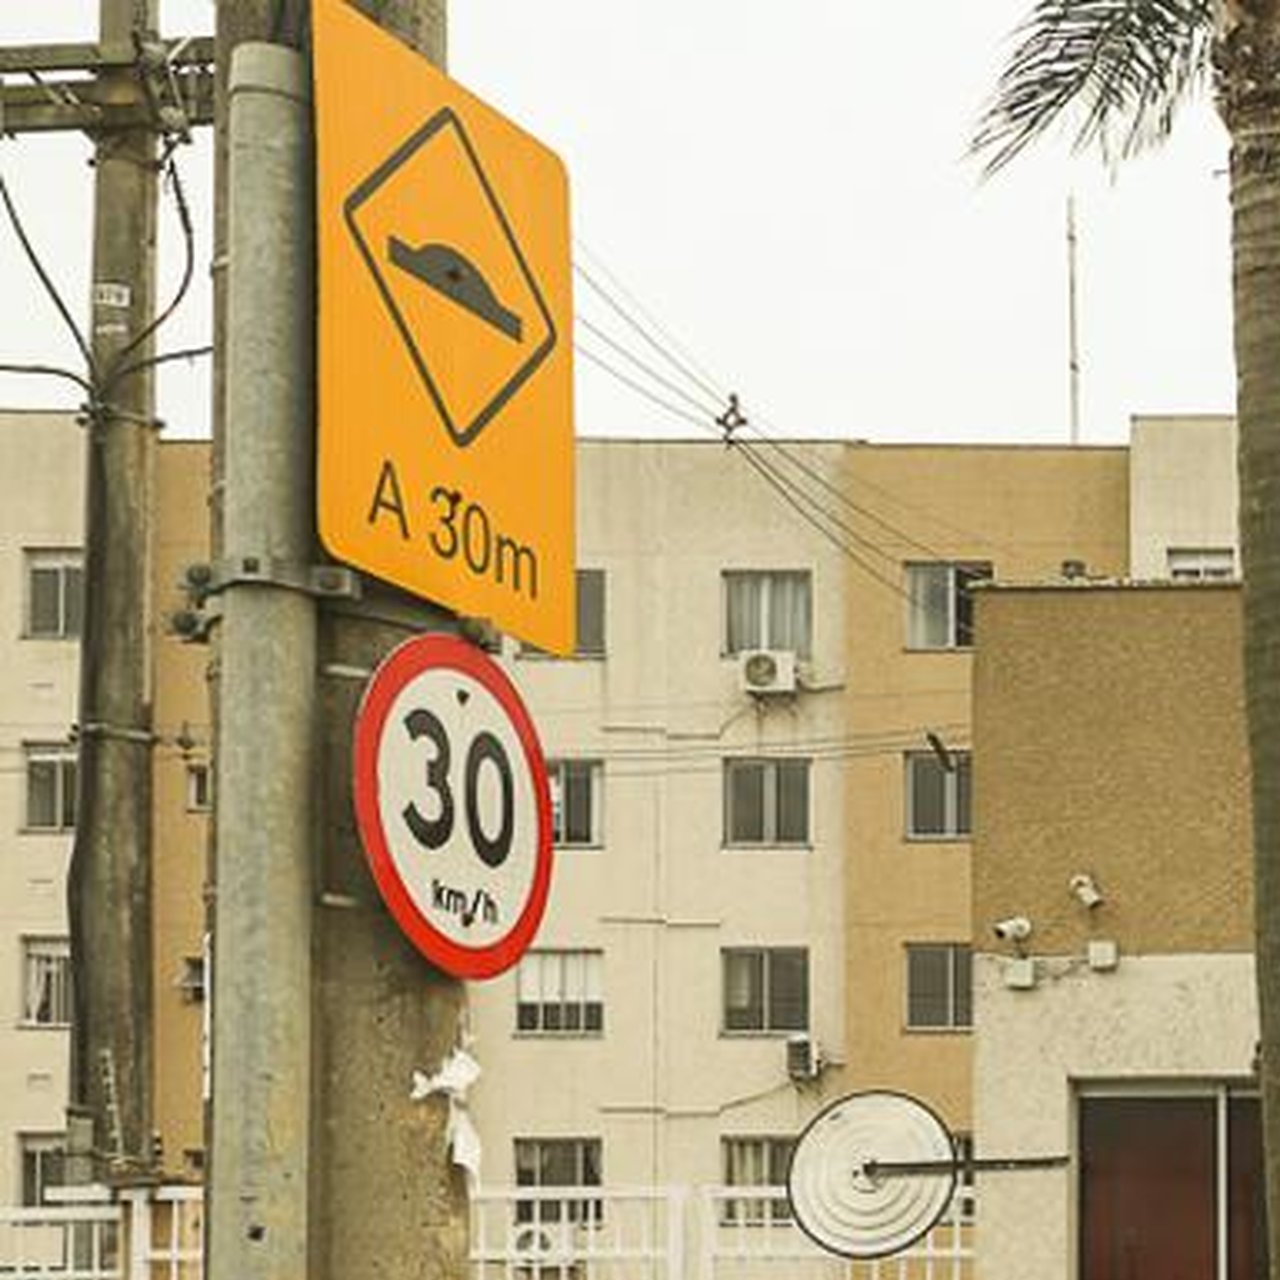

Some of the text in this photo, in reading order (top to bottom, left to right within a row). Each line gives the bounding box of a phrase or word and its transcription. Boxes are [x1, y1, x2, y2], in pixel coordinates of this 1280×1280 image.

[368, 460, 537, 600] A 30m
[402, 708, 515, 868] 30
[432, 879, 498, 924] km/h
